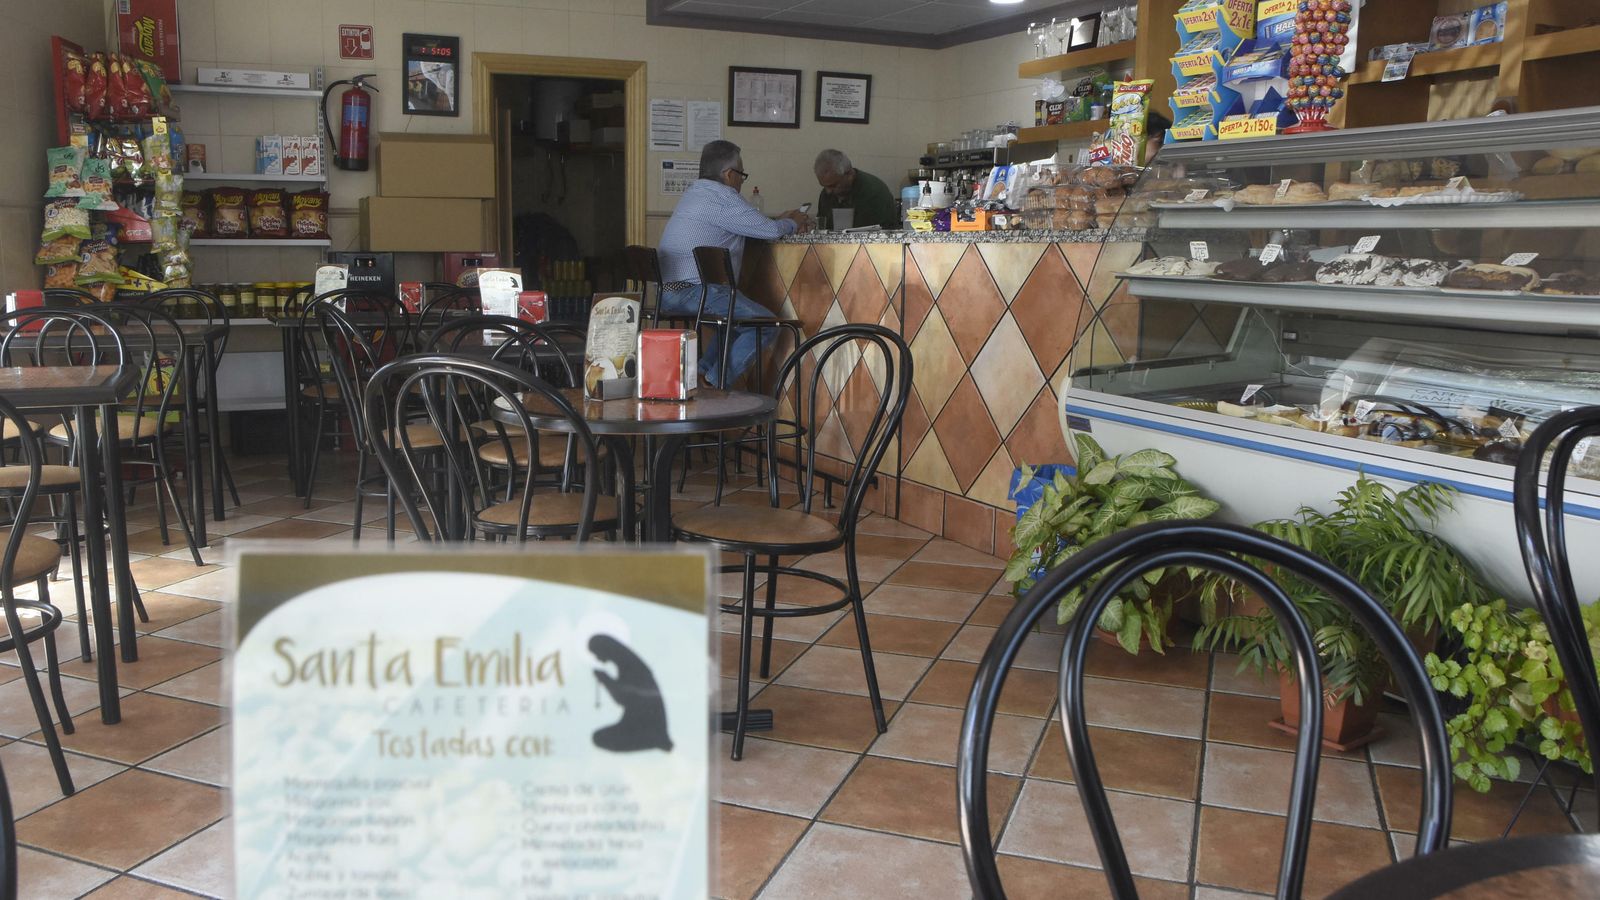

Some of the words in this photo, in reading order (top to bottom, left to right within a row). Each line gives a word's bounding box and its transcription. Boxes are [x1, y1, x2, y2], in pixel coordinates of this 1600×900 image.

[1228, 0, 1253, 13] OFERTA
[1263, 2, 1286, 15] OFERTA
[1183, 16, 1201, 25] OFERTA
[1275, 18, 1296, 34] HALL
[1178, 60, 1199, 70] OFERTA
[1220, 122, 1243, 134] OFERTA
[270, 631, 413, 691] Santa
[435, 631, 566, 688] Emilia
[371, 726, 496, 760] Tostadas
